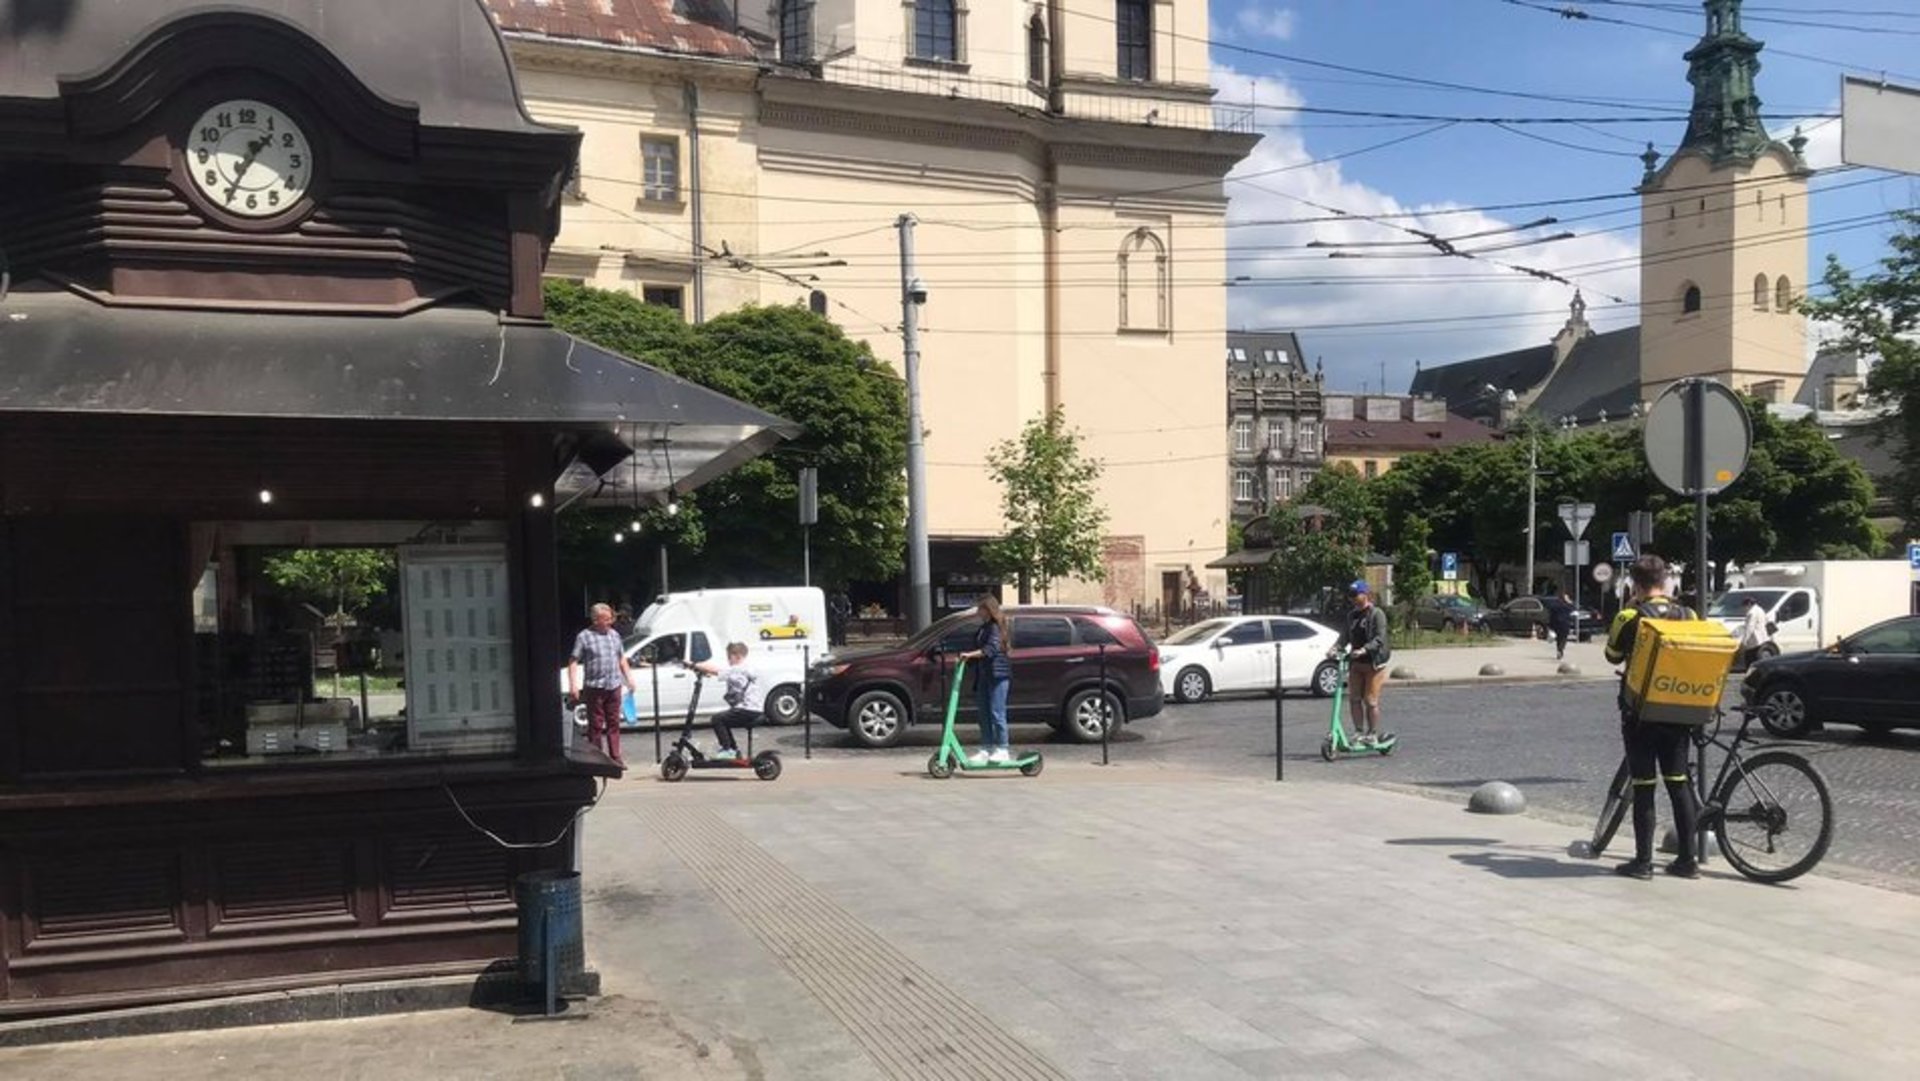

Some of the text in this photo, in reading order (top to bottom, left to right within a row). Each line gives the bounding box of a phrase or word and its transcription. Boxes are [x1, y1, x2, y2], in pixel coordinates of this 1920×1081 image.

[217, 112, 232, 128] 11
[239, 109, 256, 123] 12
[267, 116, 274, 131] 1
[201, 127, 219, 142] 10
[282, 133, 294, 148] 2
[197, 149, 209, 164] 9
[290, 154, 301, 168] 3
[205, 170, 217, 186] 8
[284, 175, 295, 191] 4
[246, 194, 257, 209] 6
[268, 190, 279, 206] 5
[1654, 675, 1715, 696] Glovo
